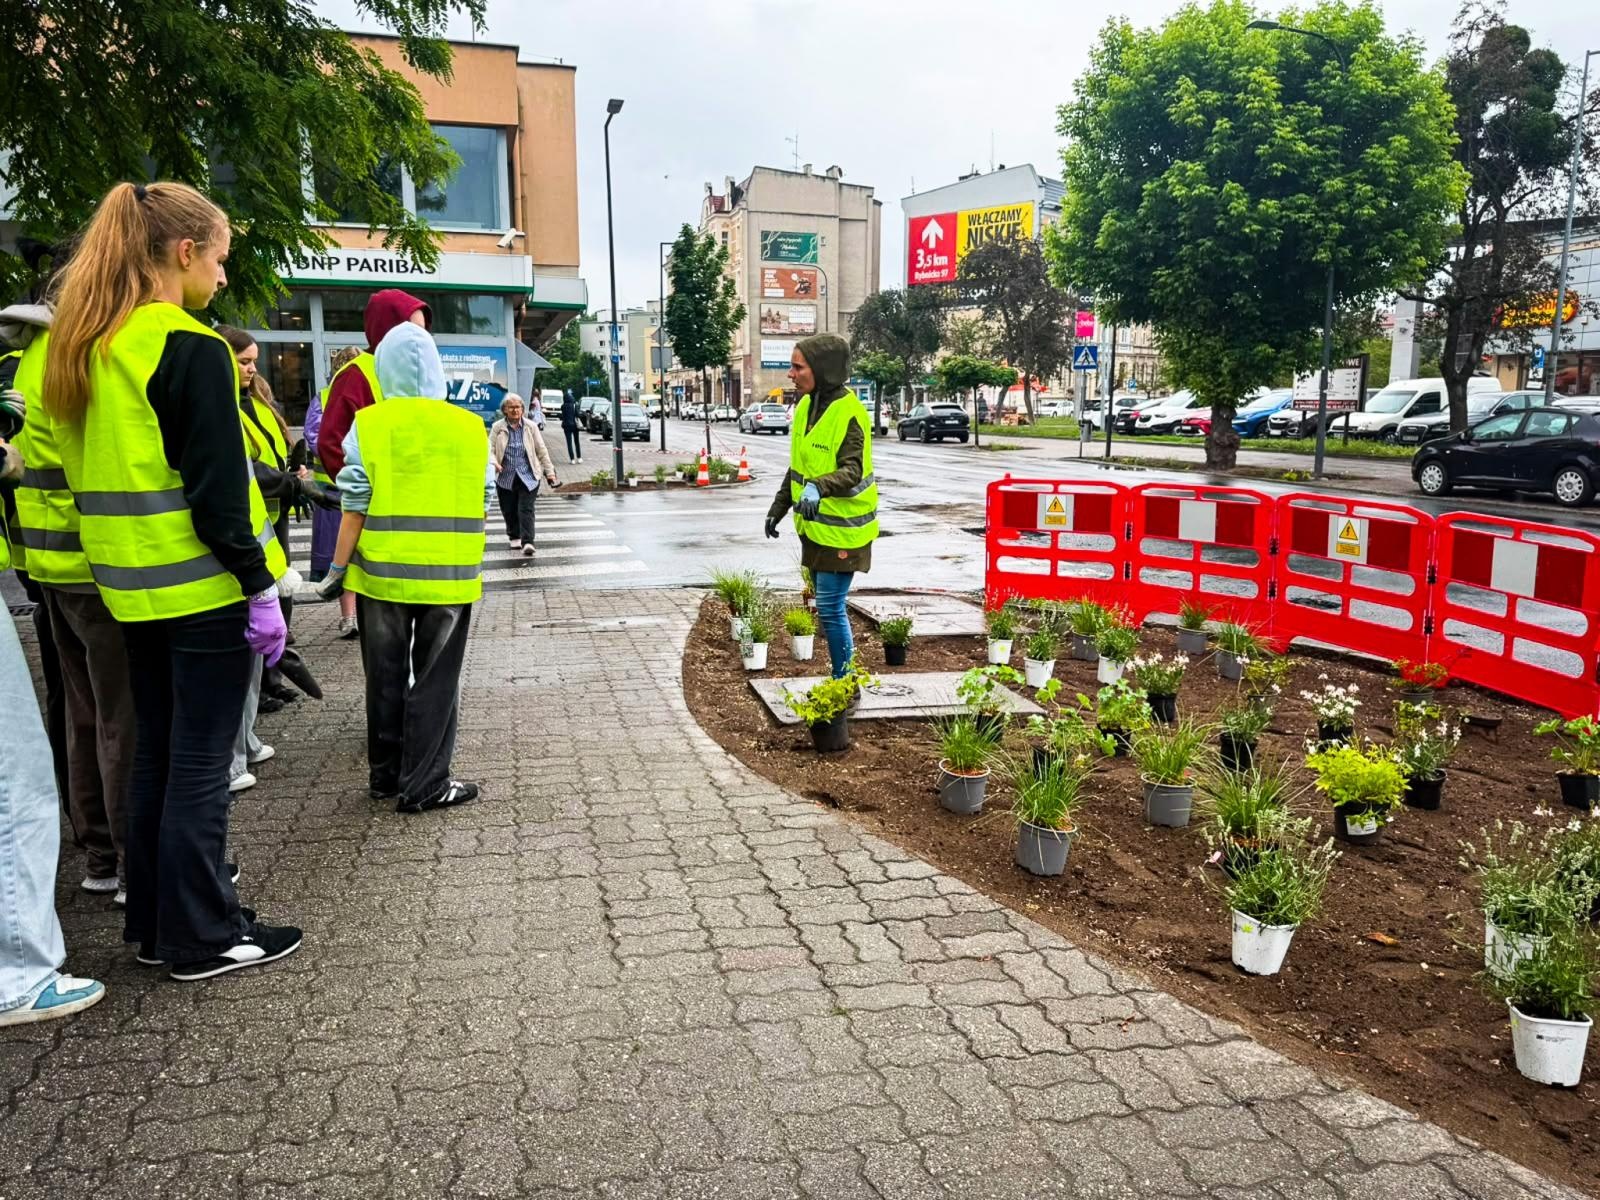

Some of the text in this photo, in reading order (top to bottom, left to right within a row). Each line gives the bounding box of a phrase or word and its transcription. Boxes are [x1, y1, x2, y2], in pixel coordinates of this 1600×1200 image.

[297, 256, 436, 275] BNP PARIBAS
[915, 249, 948, 269] 3,5 km
[453, 372, 490, 403] 7,5%
